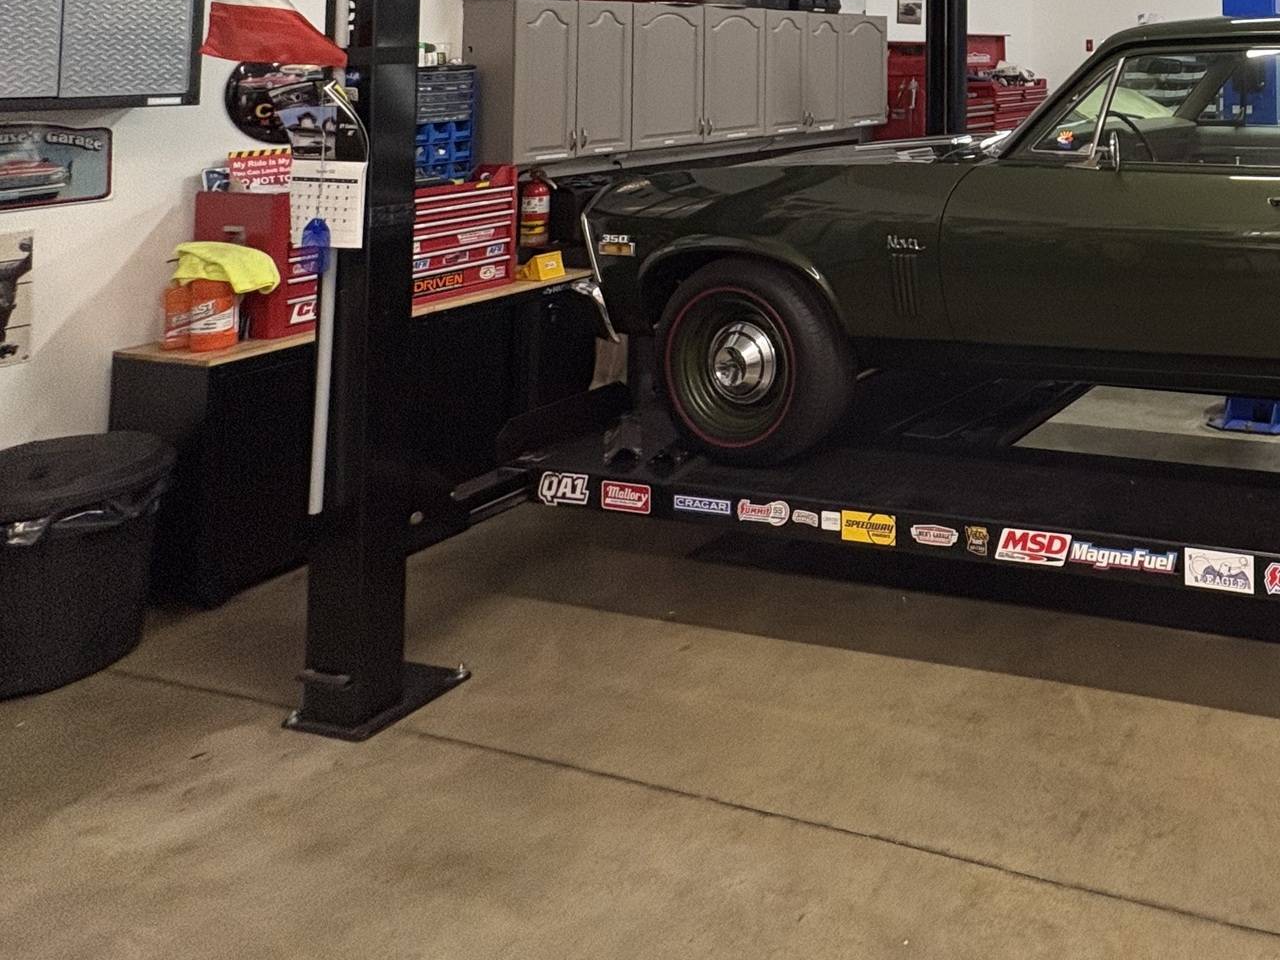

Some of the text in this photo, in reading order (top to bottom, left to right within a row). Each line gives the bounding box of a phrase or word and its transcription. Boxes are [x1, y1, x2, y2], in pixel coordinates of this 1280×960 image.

[46, 132, 102, 150] Garage
[602, 234, 628, 243] 350
[414, 274, 463, 292] DRIVEN
[540, 474, 587, 503] QA1
[606, 485, 649, 502] Mallory
[676, 498, 728, 511] CRAGAR
[844, 520, 894, 533] SPEEDWAY
[1001, 530, 1068, 555] MSD
[1070, 542, 1176, 571] MagnaFuel
[1205, 574, 1246, 589] EAGLE
